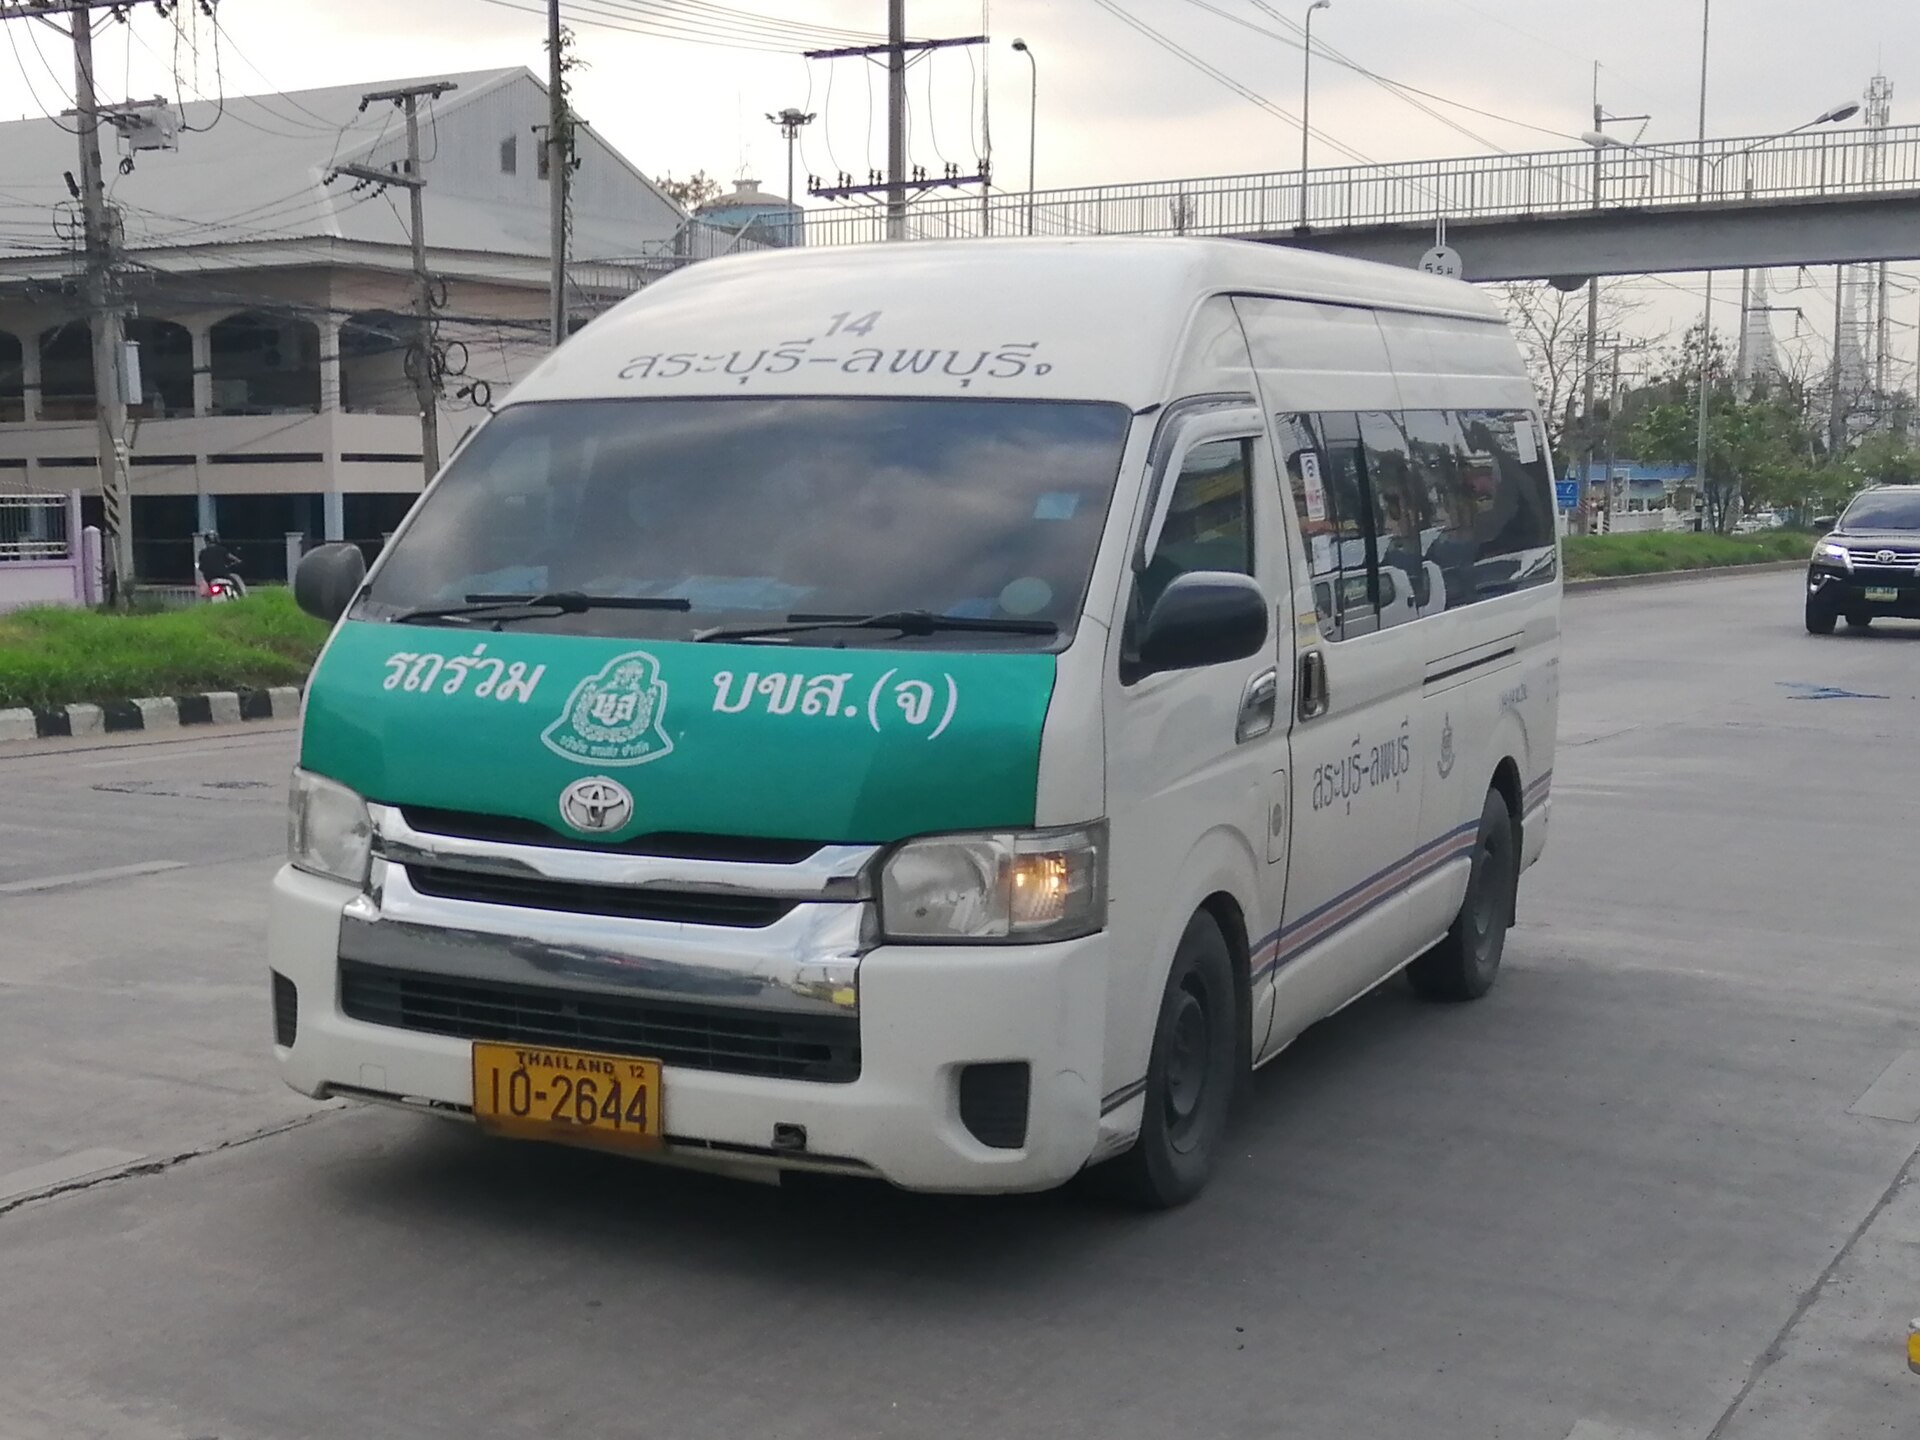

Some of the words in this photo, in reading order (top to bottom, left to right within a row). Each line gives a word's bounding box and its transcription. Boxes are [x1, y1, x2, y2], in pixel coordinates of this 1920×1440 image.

[824, 311, 882, 338] 14
[383, 643, 547, 704] รถร่วม
[1313, 714, 1410, 816] สระบุรี-ลพบุรี
[516, 1050, 615, 1074] THAILAND
[629, 1064, 646, 1079] 12
[491, 1066, 648, 1134] 10-2644
